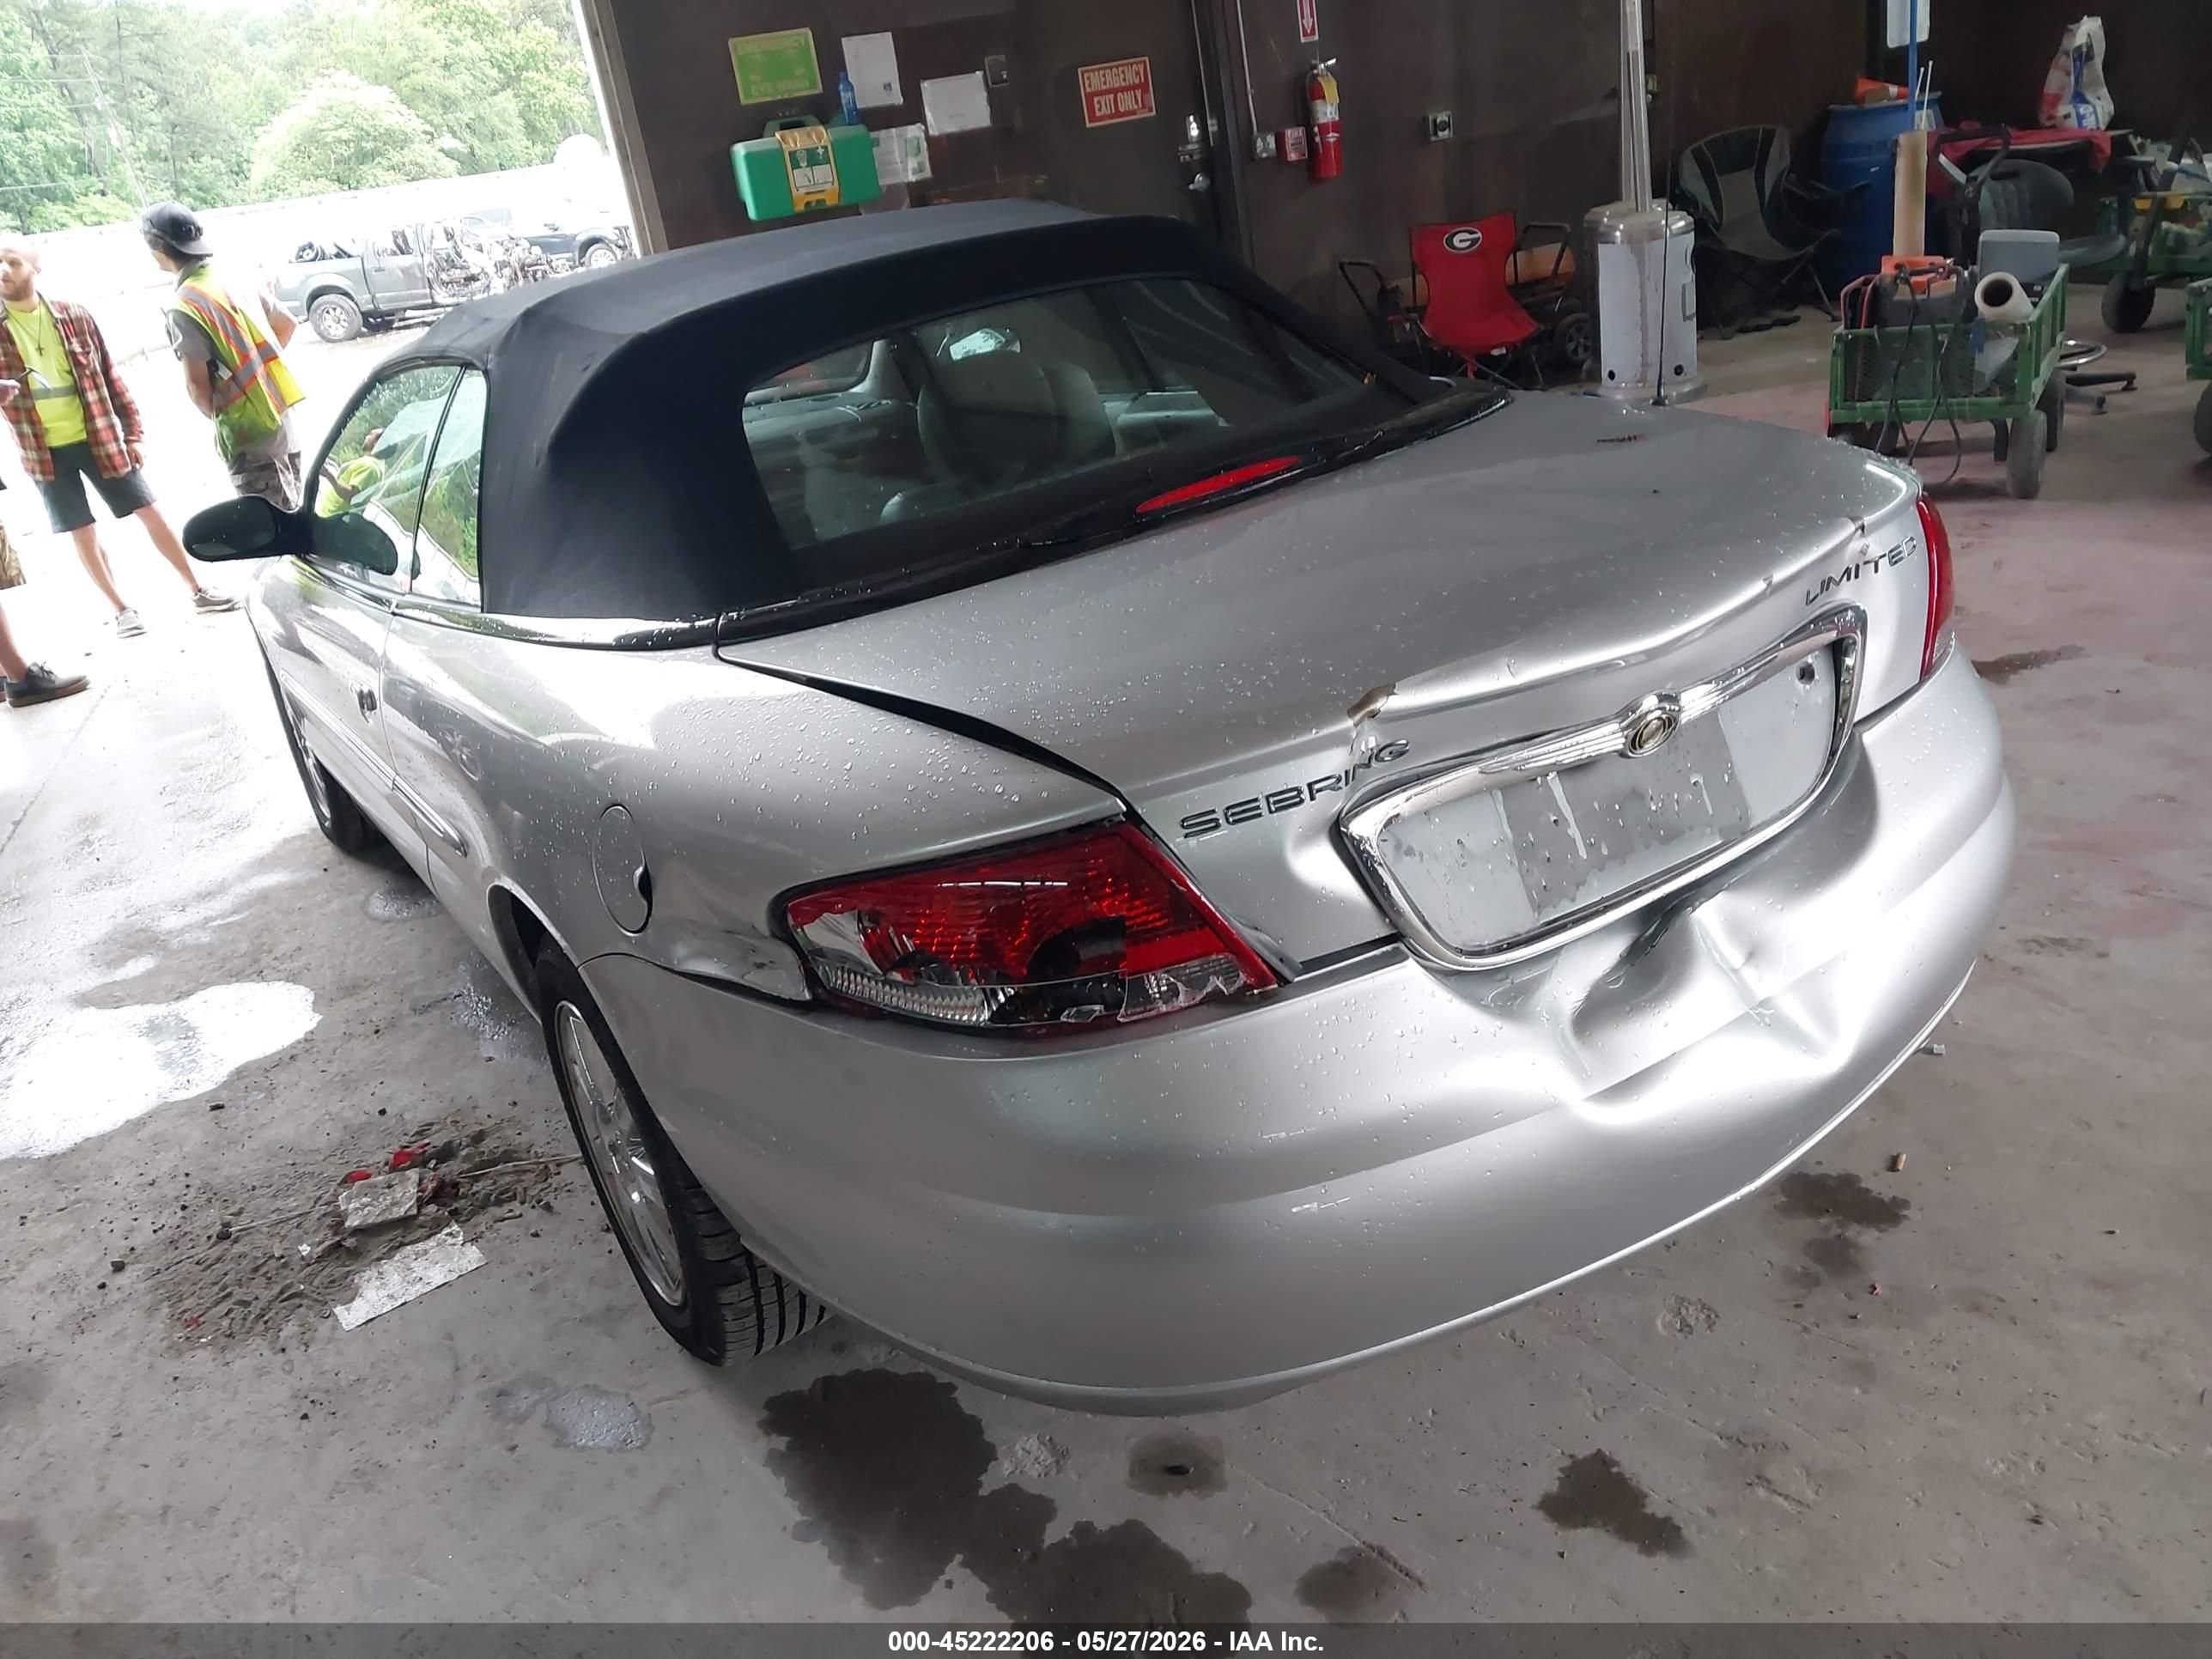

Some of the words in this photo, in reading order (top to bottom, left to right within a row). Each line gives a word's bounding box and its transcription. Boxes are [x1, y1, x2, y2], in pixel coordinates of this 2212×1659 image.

[1084, 62, 1145, 92] EMERGENCY
[1093, 94, 1115, 117] EXIT
[1116, 88, 1143, 112] ONLY
[1805, 536, 1917, 606] LIMITED
[1180, 738, 1410, 839] SEBRING
